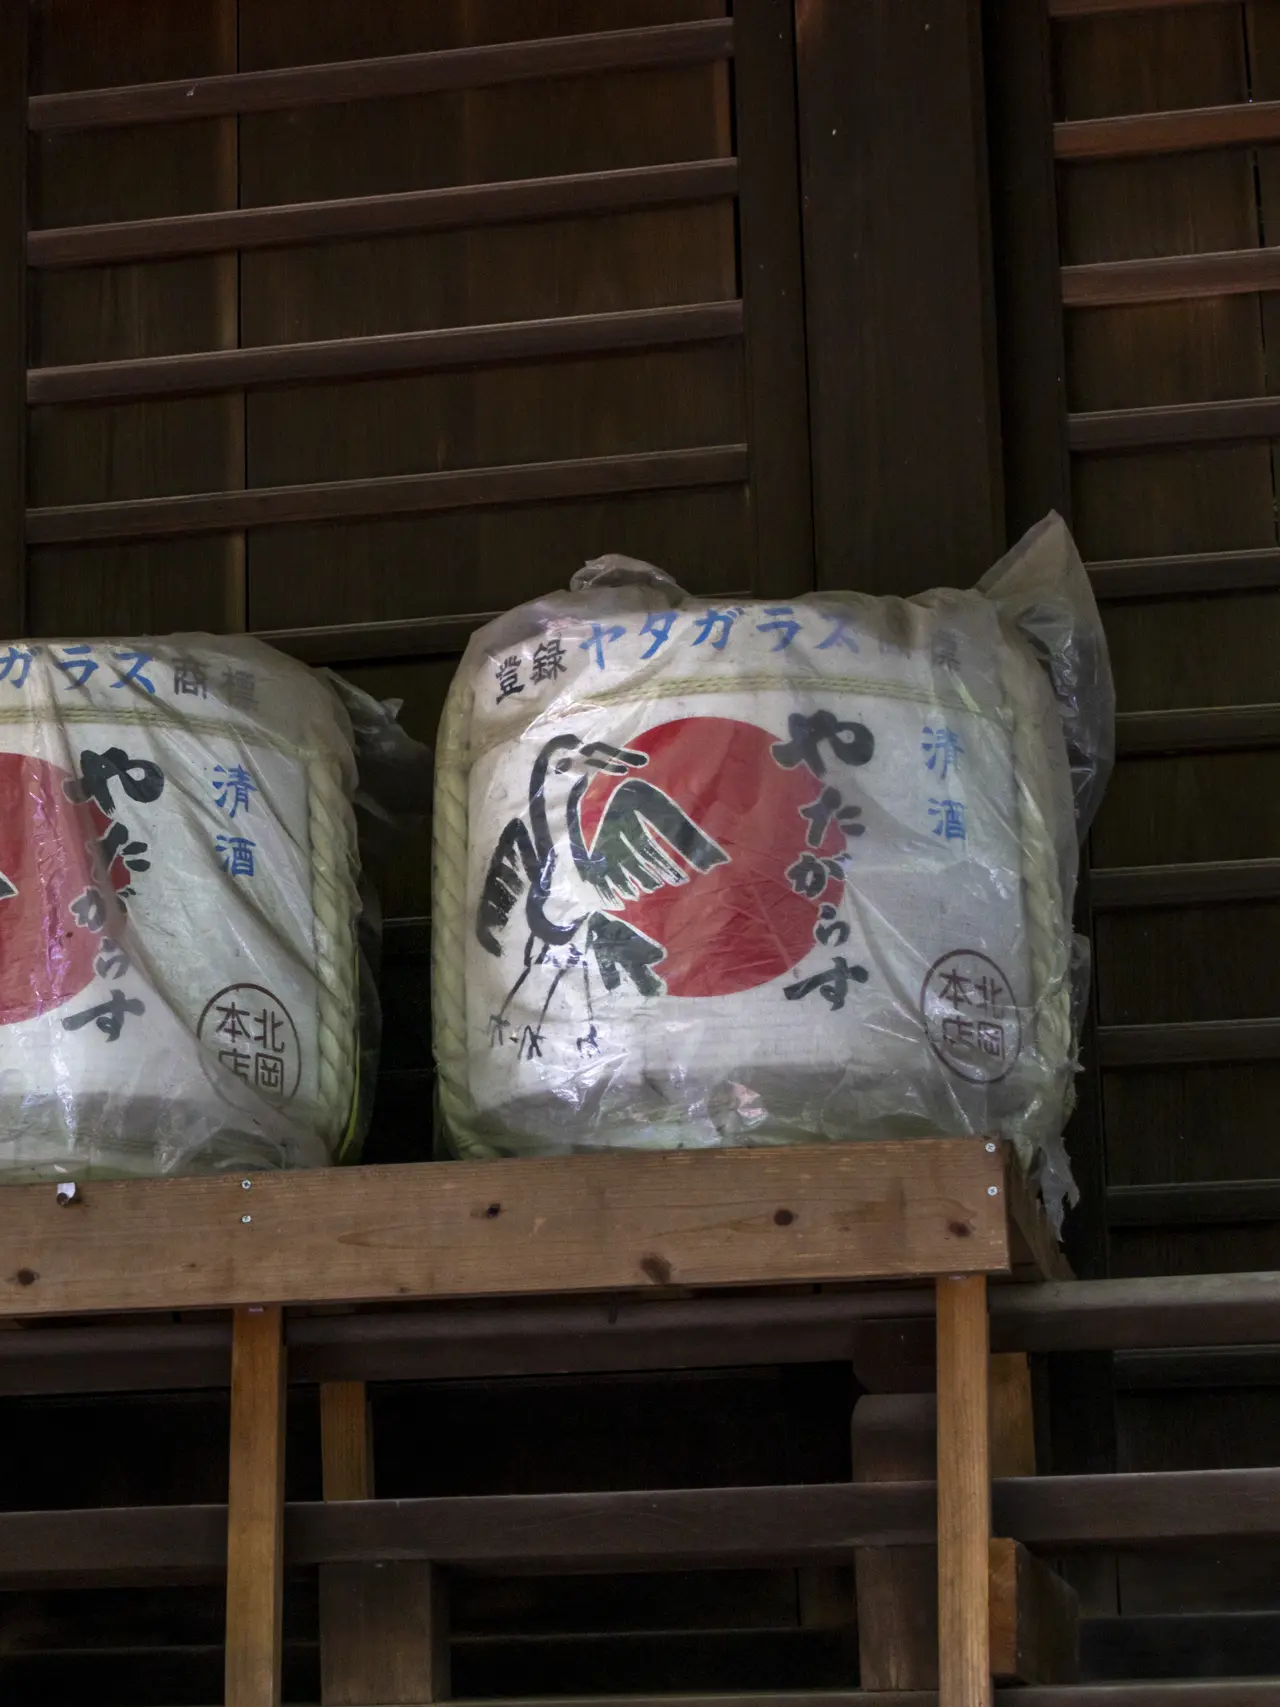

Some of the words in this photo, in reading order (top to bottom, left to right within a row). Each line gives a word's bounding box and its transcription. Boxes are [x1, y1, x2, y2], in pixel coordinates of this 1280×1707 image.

[496, 637, 567, 704] 登録
[579, 608, 859, 670] ヤタガラス
[212, 764, 257, 877] 清酒
[921, 726, 965, 841] 清酒
[61, 747, 165, 1043] やたがらす
[771, 709, 874, 1011] やたがらす
